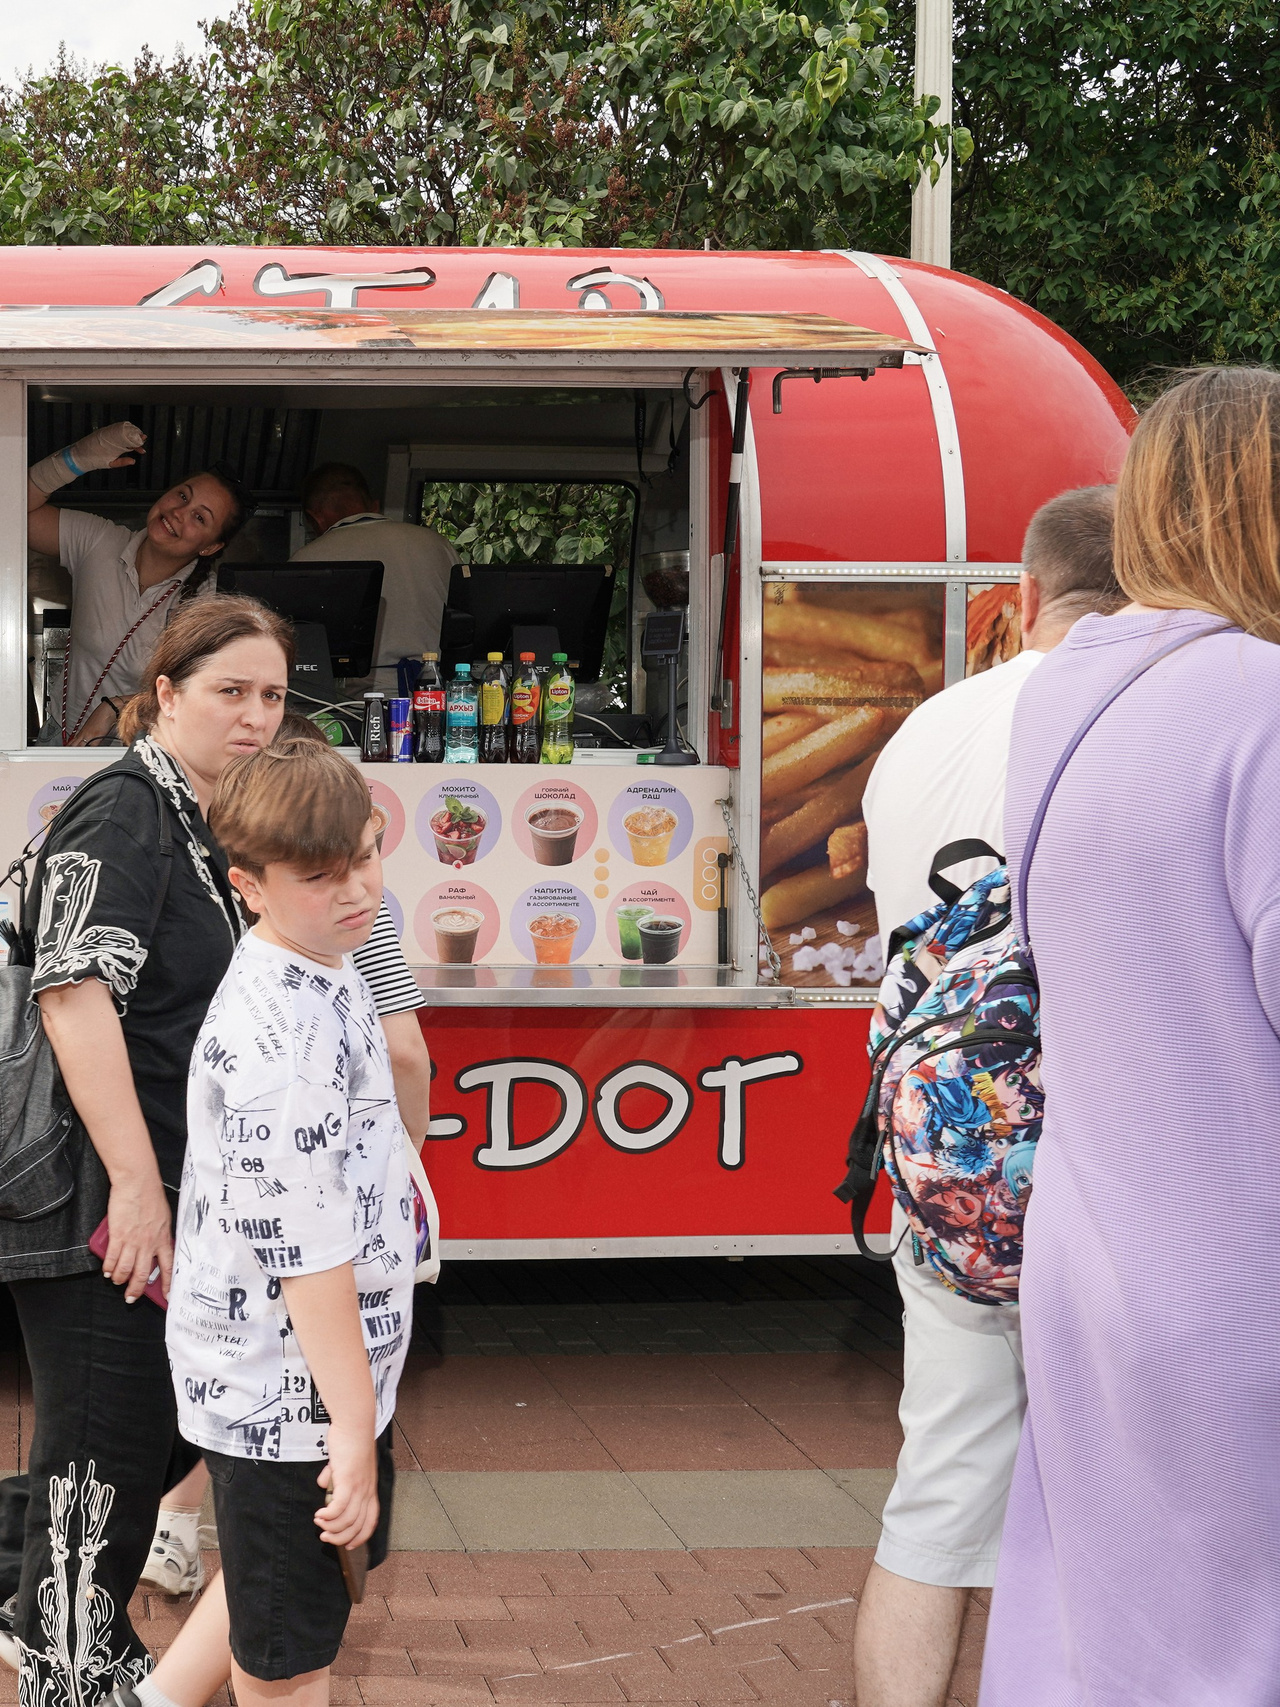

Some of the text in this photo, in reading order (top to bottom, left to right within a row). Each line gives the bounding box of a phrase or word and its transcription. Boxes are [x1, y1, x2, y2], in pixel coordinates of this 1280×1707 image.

[449, 704, 474, 712] АРХЫЗ
[370, 716, 381, 741] Rich
[364, 1310, 401, 1339] WITH
